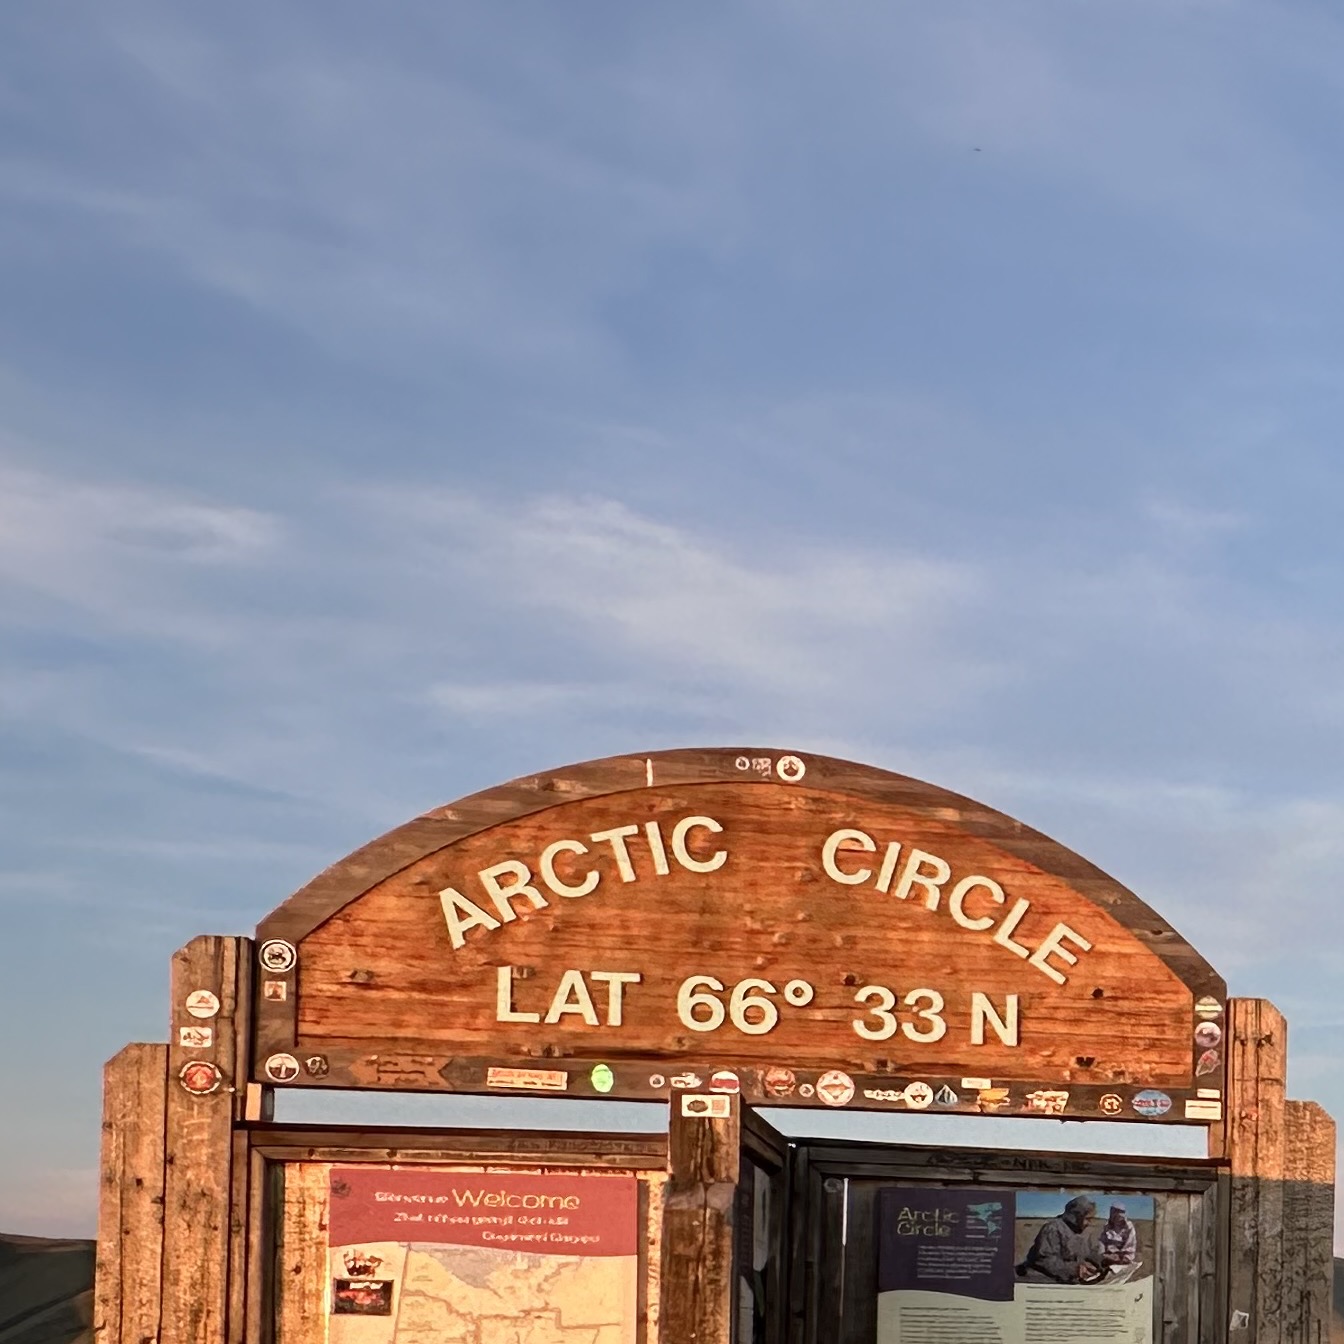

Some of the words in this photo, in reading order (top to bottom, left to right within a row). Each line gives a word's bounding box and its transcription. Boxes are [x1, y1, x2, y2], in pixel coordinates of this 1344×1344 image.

[438, 815, 729, 951] ARCTIC
[821, 827, 1093, 986] CIRCLE
[495, 964, 642, 1027] LAT
[676, 974, 815, 1036] 66°
[851, 984, 948, 1044] 33
[969, 991, 1020, 1048] N
[451, 1188, 581, 1210] Welcome
[896, 1206, 960, 1223] Arctic
[896, 1221, 952, 1236] Circle
